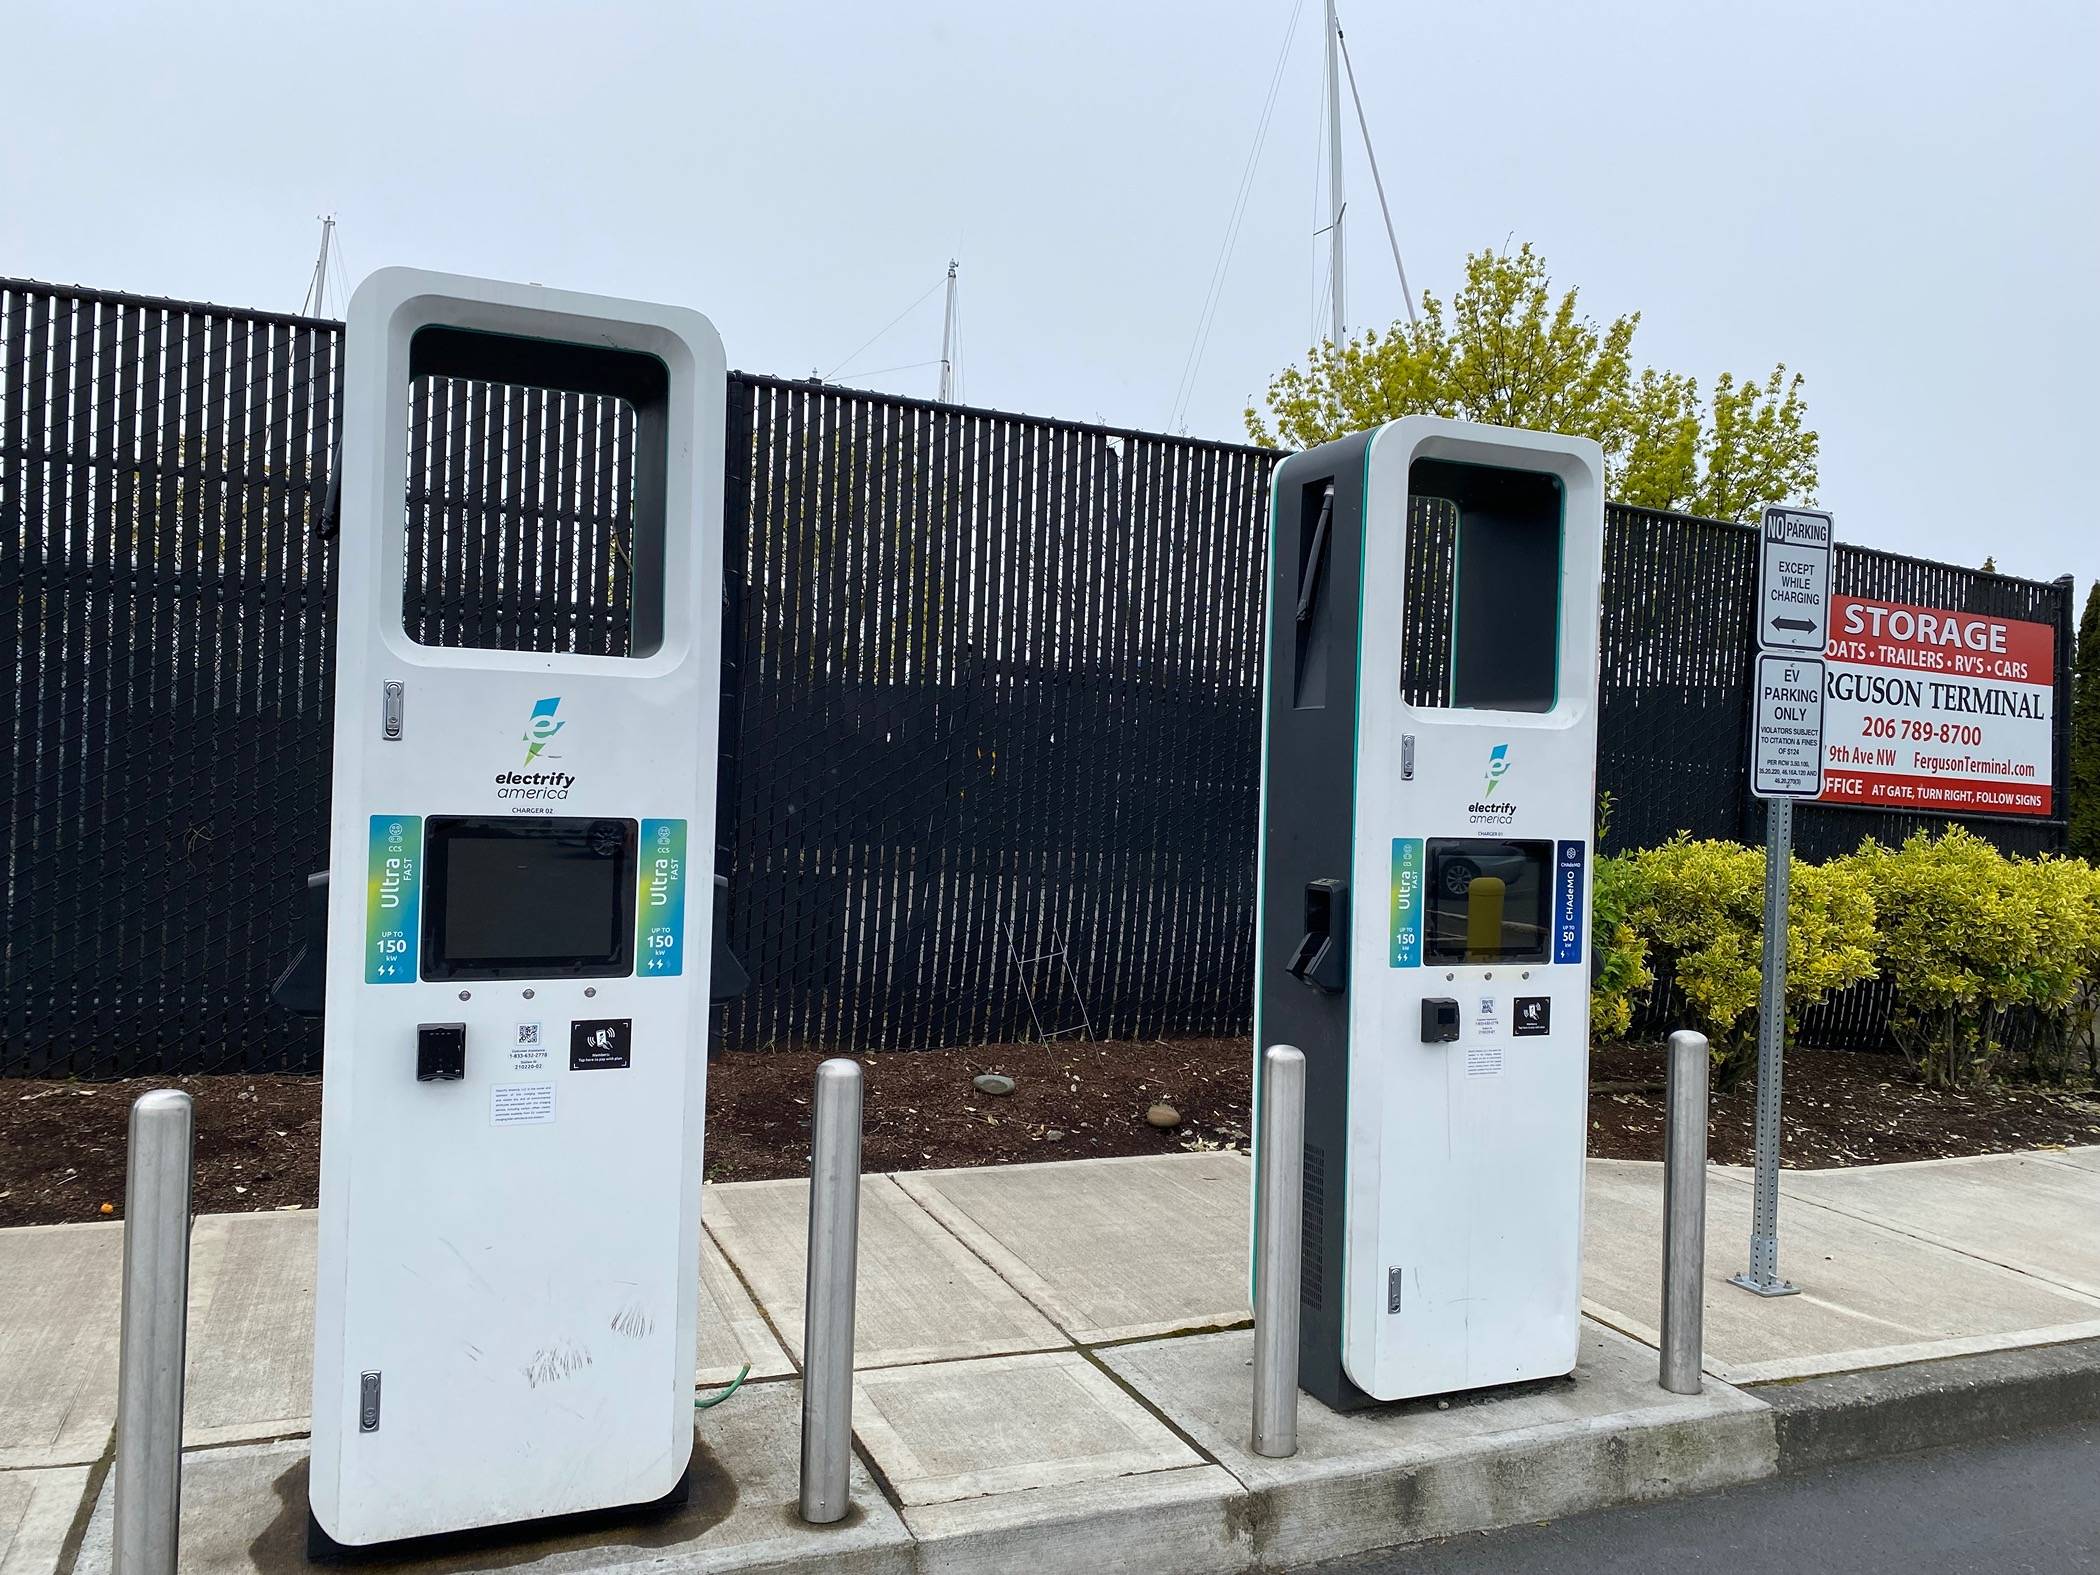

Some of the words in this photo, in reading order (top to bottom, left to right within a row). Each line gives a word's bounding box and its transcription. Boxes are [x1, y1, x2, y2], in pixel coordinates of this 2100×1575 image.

[1767, 515, 1784, 540] NO
[1786, 521, 1827, 541] PARKING
[1778, 560, 1815, 576] EXCEPT
[1781, 575, 1811, 590] WHILE
[1770, 589, 1820, 605] CHARGING
[1844, 603, 2007, 654] STORAGE
[1826, 639, 1866, 660] OATS
[1878, 645, 1944, 669] TRAILERS
[1955, 655, 1984, 674] RV'S
[1994, 660, 2028, 679] CARS
[1784, 669, 1800, 682] EV
[1764, 687, 1818, 703] PARKING
[1827, 671, 1923, 708] RGUSON
[1929, 682, 2045, 720] TERMINAL
[1774, 706, 1807, 722] ONLY
[1760, 726, 1793, 734] VIOLATORS
[1793, 728, 1819, 736] SUBJECT
[1862, 716, 1896, 739] 206
[1901, 719, 1981, 746] 789-8700
[1770, 737, 1795, 745] CITATION
[1778, 747, 1786, 755] OF
[1829, 745, 1849, 763] 9th
[1852, 747, 1874, 765] Ave
[1876, 748, 1897, 766] NW
[1914, 751, 2035, 777] FergusonTerminal.com
[495, 771, 576, 789] electrify
[497, 786, 569, 800] america
[1825, 777, 1863, 795] FFICE
[1872, 784, 1886, 796] AT
[1887, 786, 1915, 800] GATE,
[1917, 787, 1943, 800] TURN
[1944, 789, 1975, 804] RIGHT,
[1976, 791, 2015, 805] FOLLOW
[2015, 795, 2042, 807] SIGNS
[1468, 802, 1517, 816] electrify
[1469, 814, 1513, 824] america
[403, 857, 413, 881] FAST
[671, 858, 679, 880] FAST
[379, 858, 401, 908] Ultra
[649, 859, 668, 906] Ultra
[1398, 871, 1411, 910] Ultra
[1565, 871, 1575, 921] CHAdeMO
[647, 935, 674, 948] 150
[1396, 933, 1415, 945] 150
[1562, 931, 1575, 942] 50
[376, 939, 407, 953] 150
